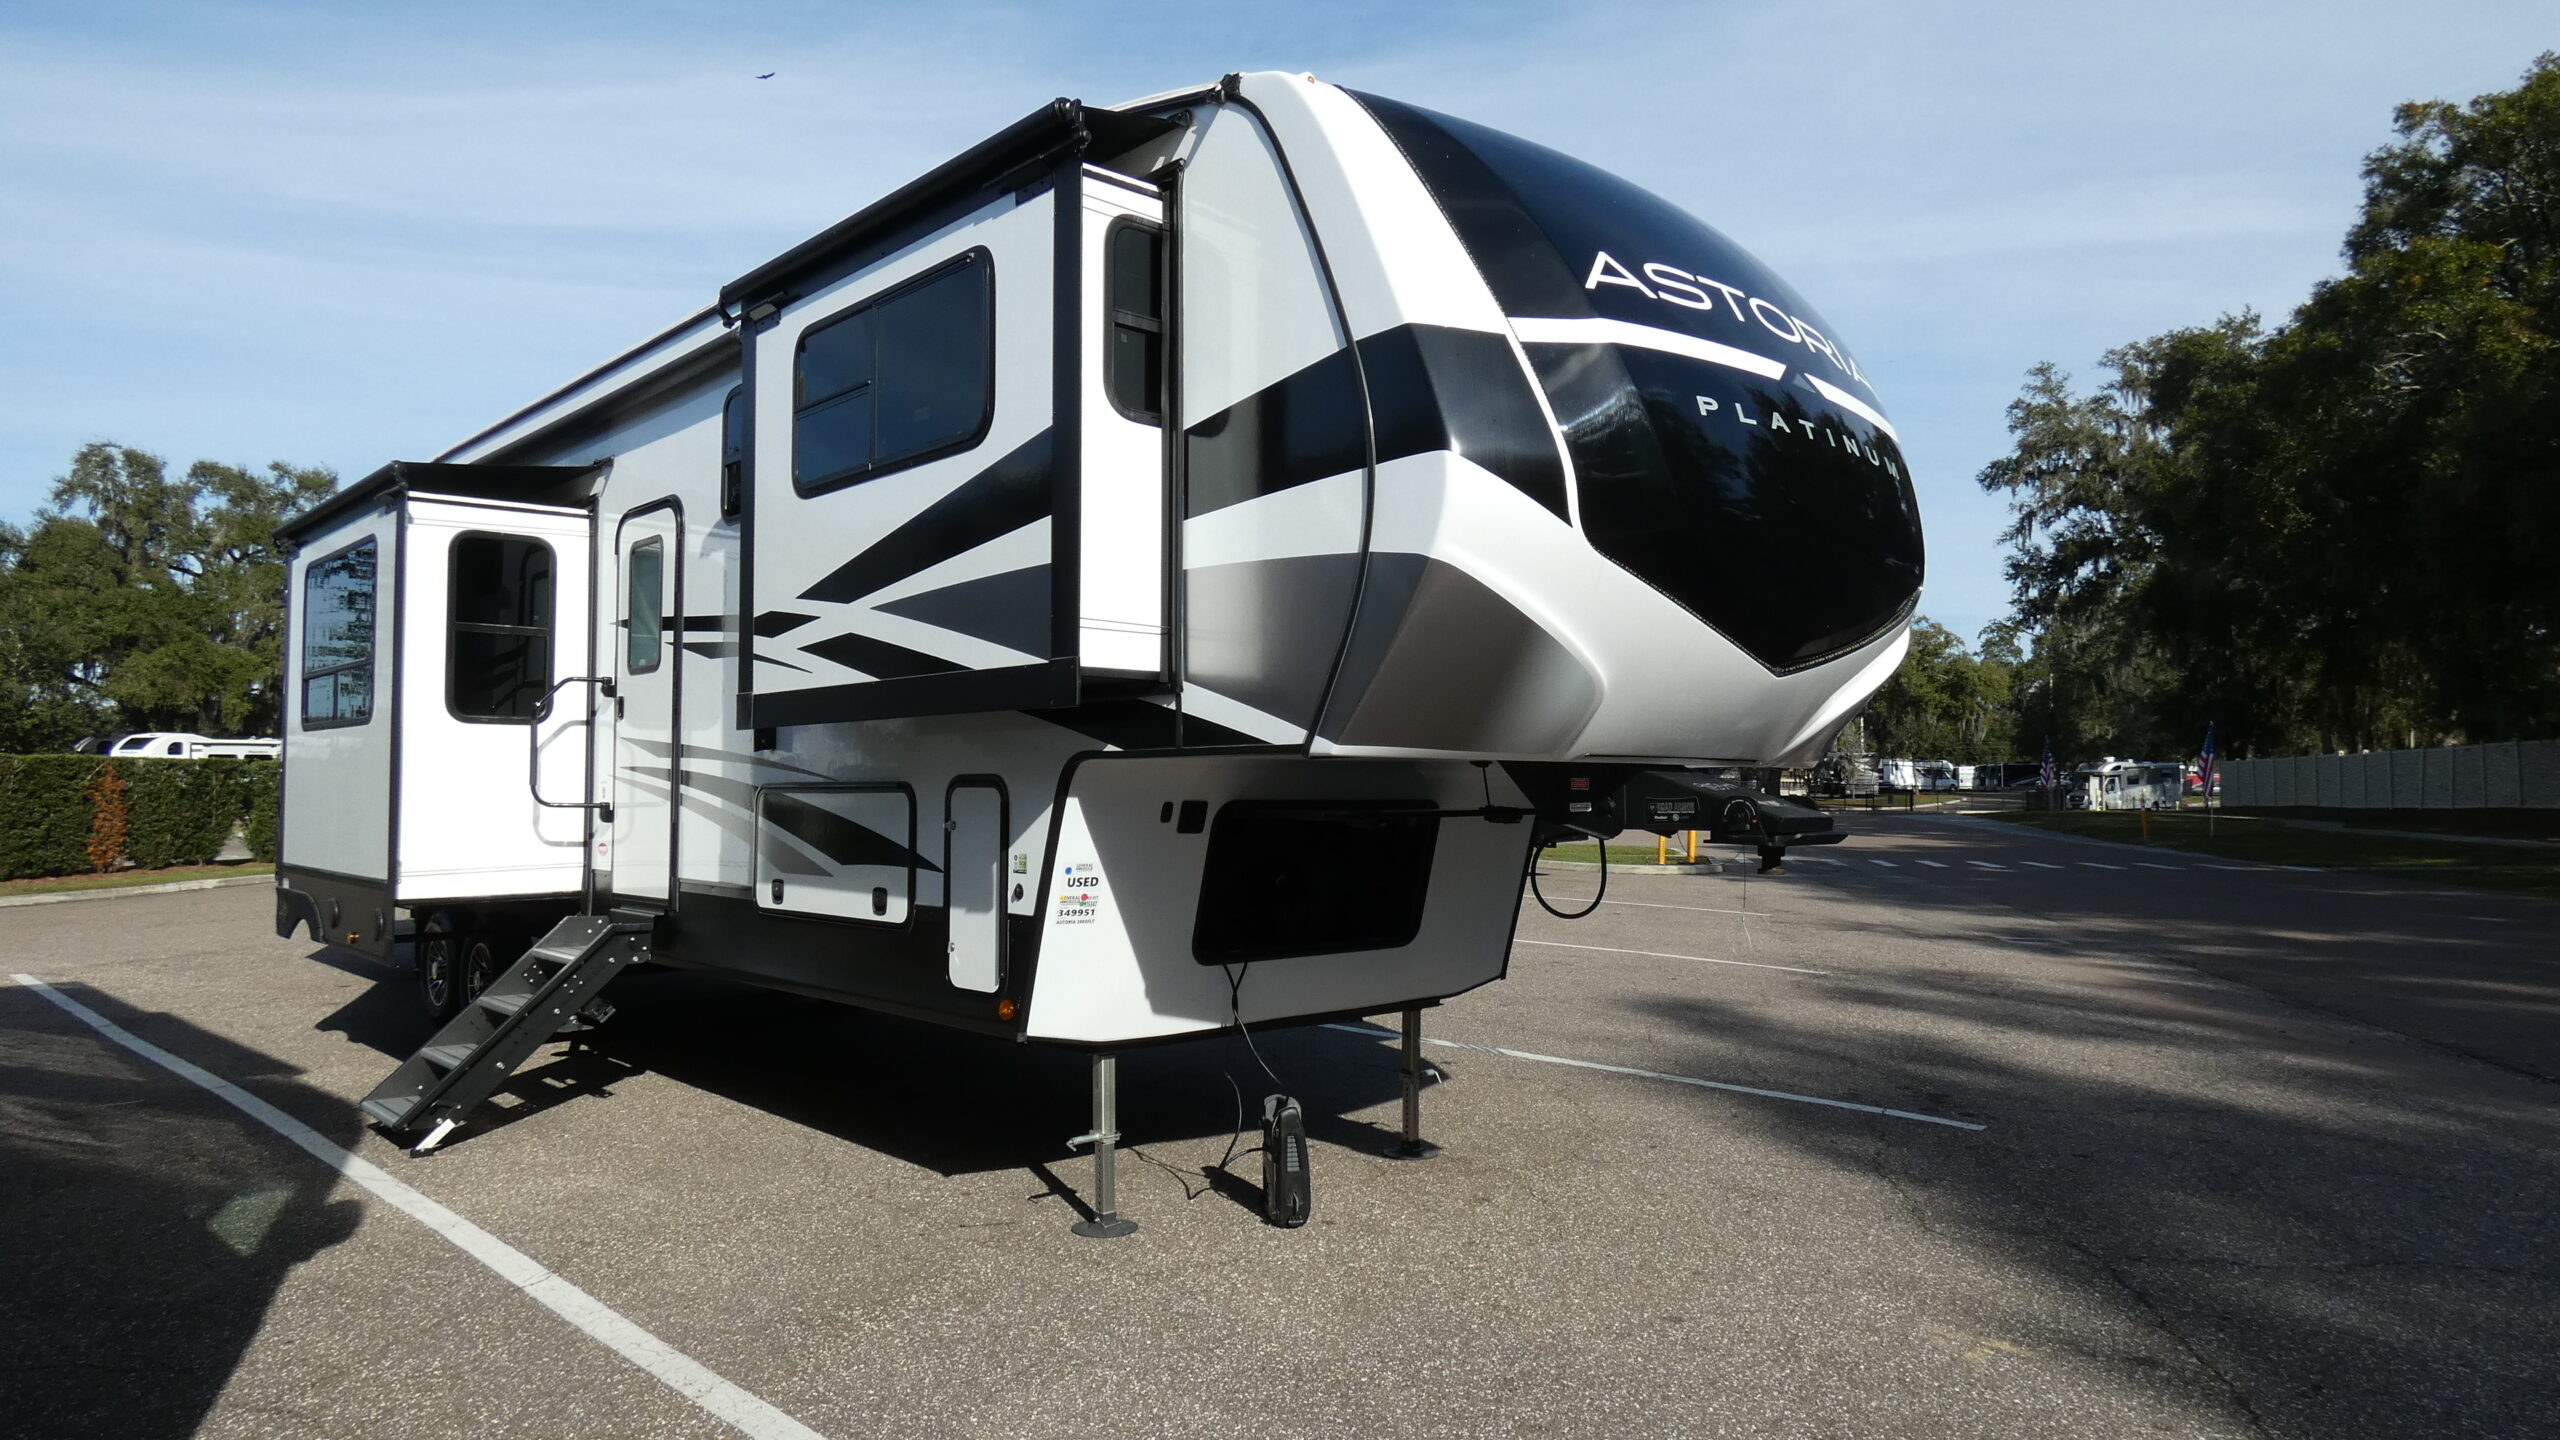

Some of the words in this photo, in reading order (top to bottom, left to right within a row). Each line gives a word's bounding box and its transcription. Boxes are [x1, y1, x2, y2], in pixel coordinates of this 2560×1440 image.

[1585, 251, 1881, 401] ASTORIA
[1696, 395, 1900, 481] PLATINUM
[1067, 876, 1099, 888] USED
[1058, 909, 1095, 917] 349951
